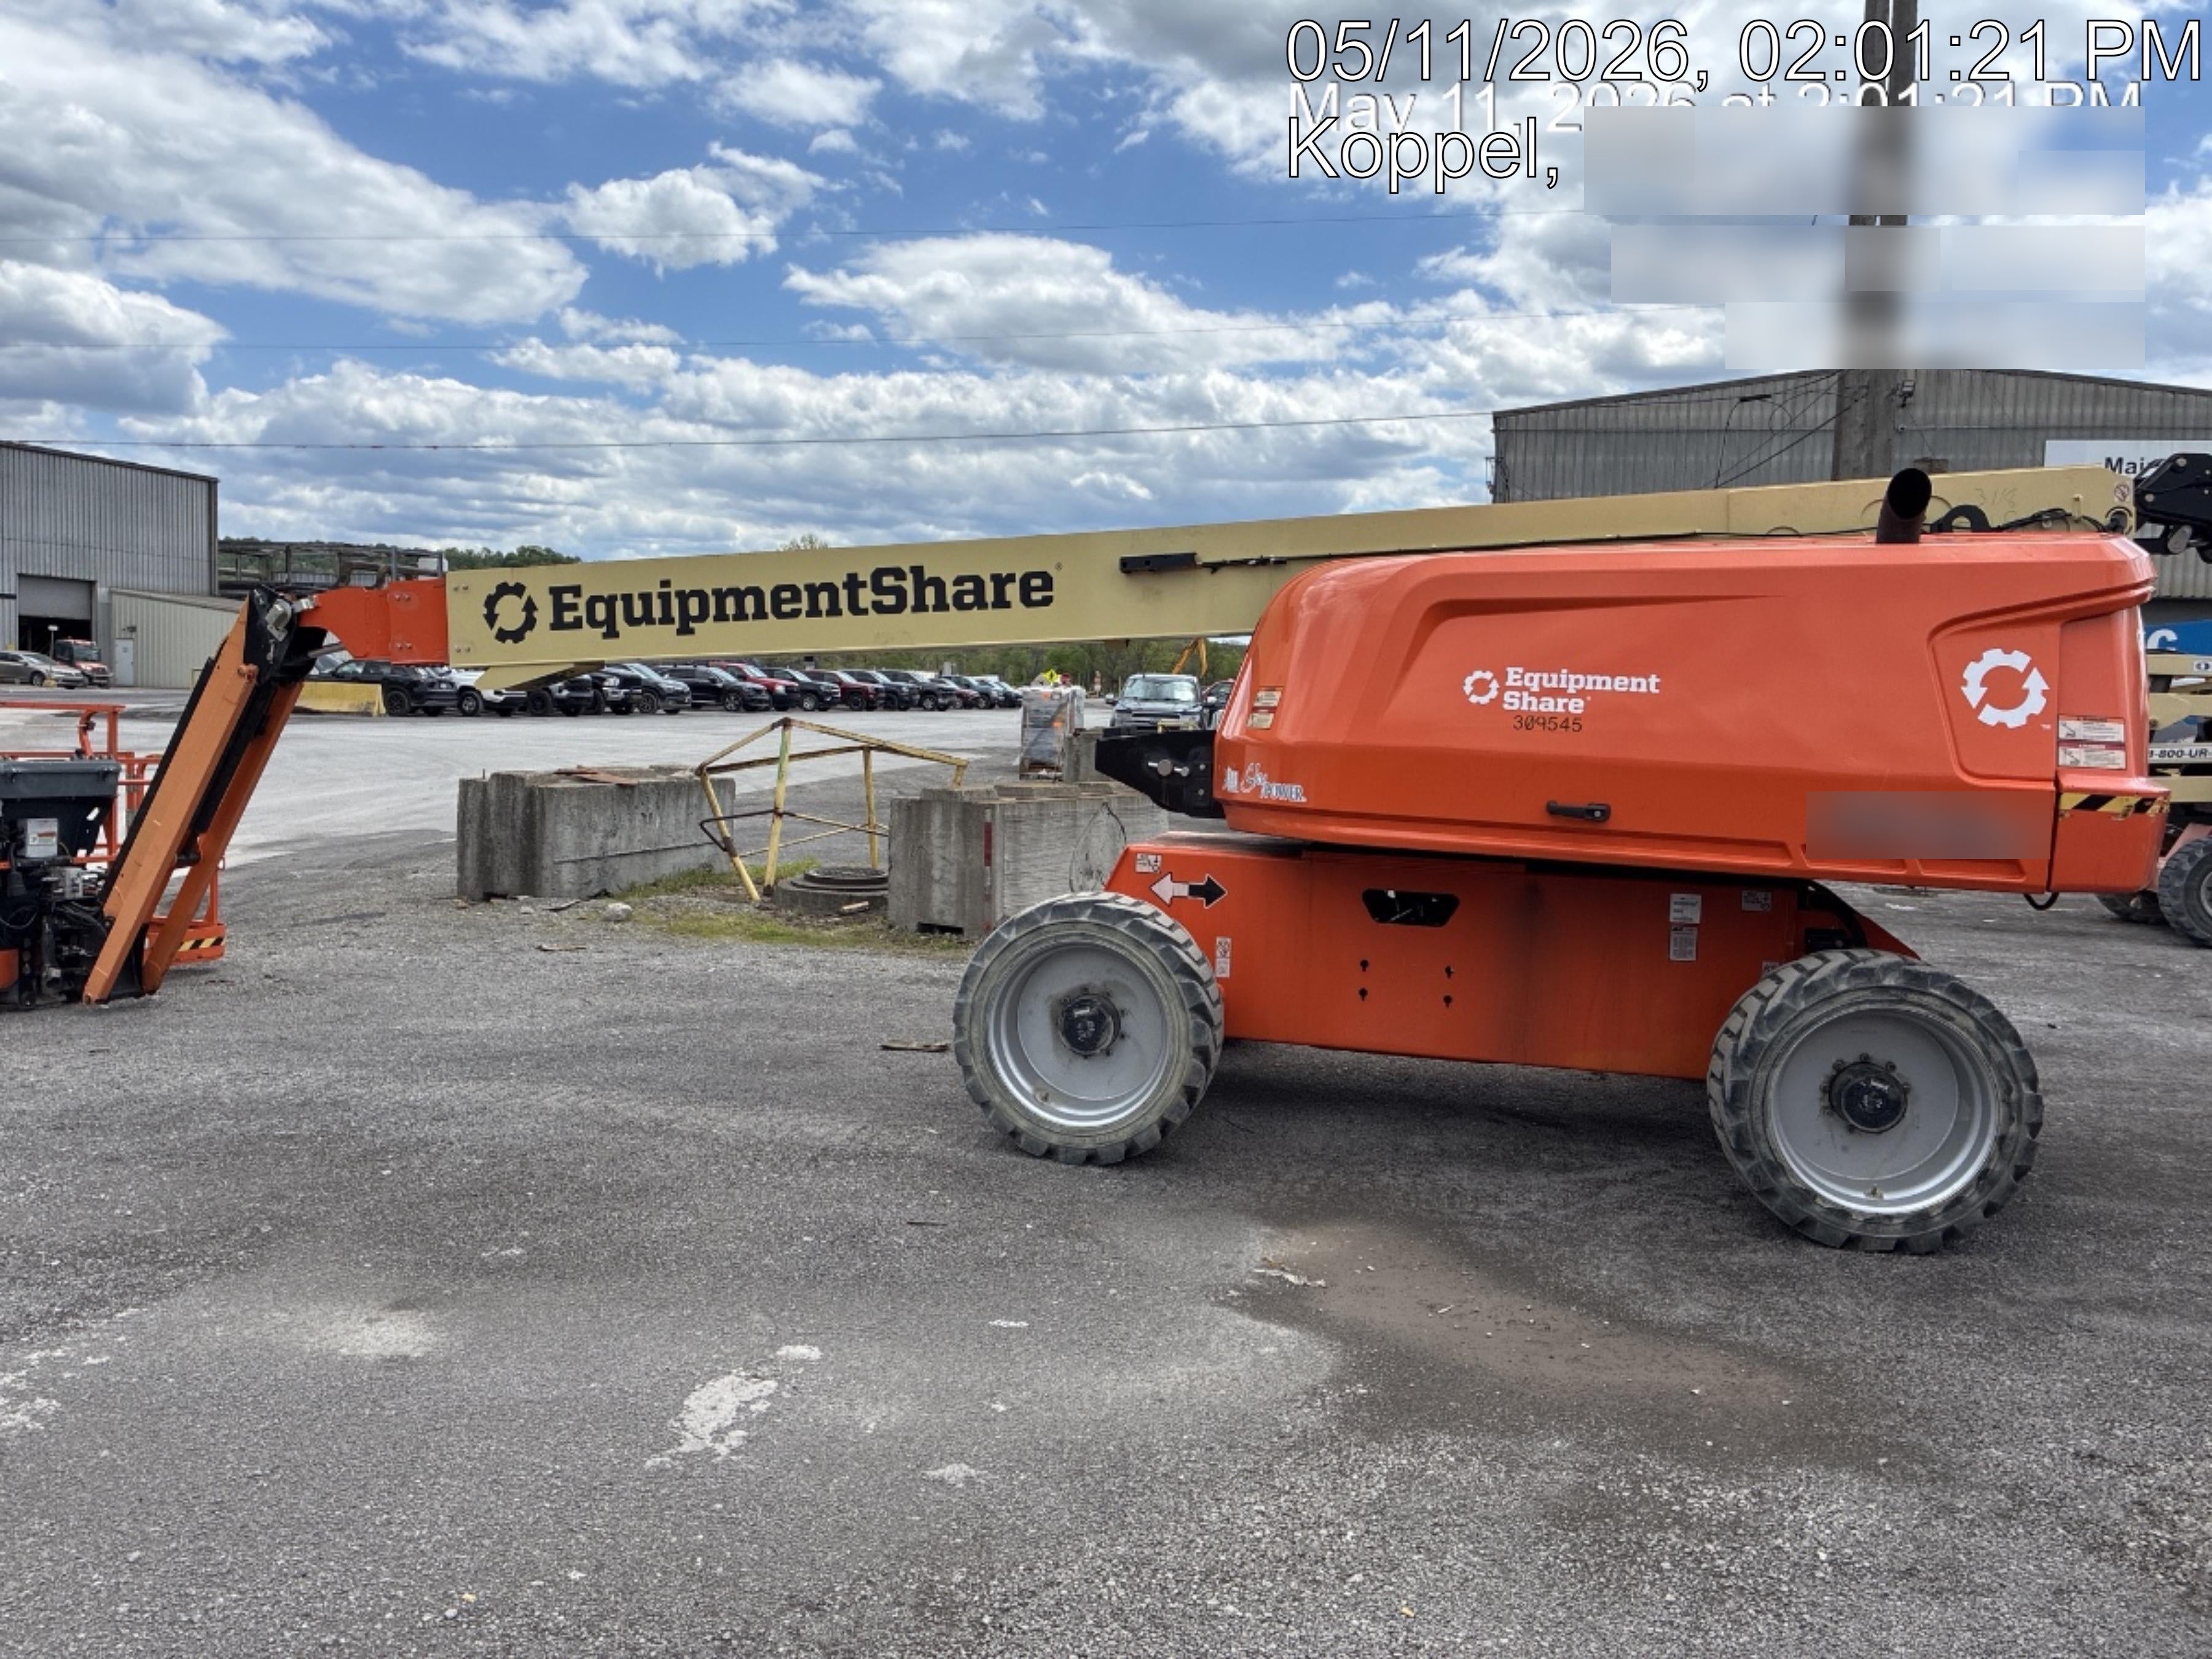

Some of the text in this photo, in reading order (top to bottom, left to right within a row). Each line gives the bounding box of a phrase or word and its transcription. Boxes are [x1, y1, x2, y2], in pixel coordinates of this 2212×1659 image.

[2104, 457, 2145, 475] Mai
[549, 565, 1054, 640] EquipmentShare
[1505, 667, 1661, 694] Equipment
[1502, 690, 1585, 714] Share
[1513, 715, 1583, 732] 309545
